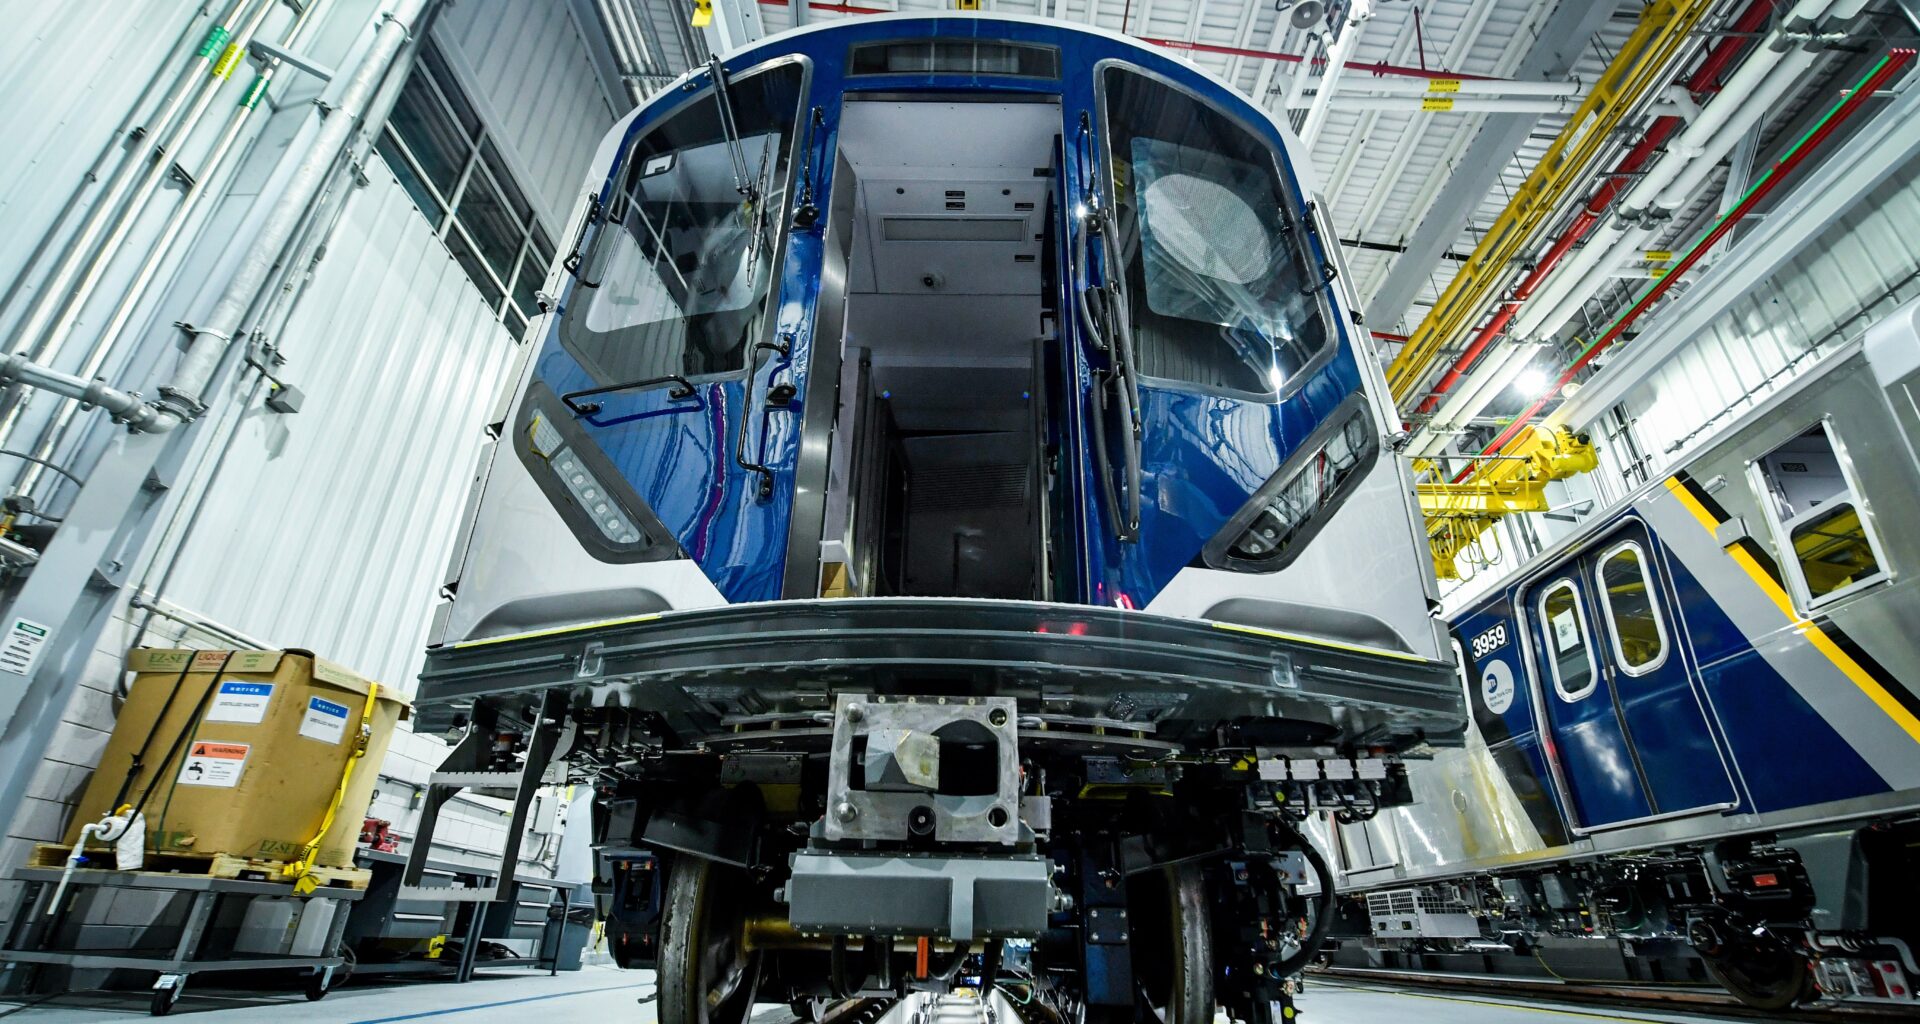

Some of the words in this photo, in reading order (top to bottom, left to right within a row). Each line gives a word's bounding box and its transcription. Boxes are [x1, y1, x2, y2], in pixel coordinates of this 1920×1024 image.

[1472, 625, 1506, 658] 3959
[197, 652, 228, 661] LIQUID
[211, 747, 246, 755] WARNING
